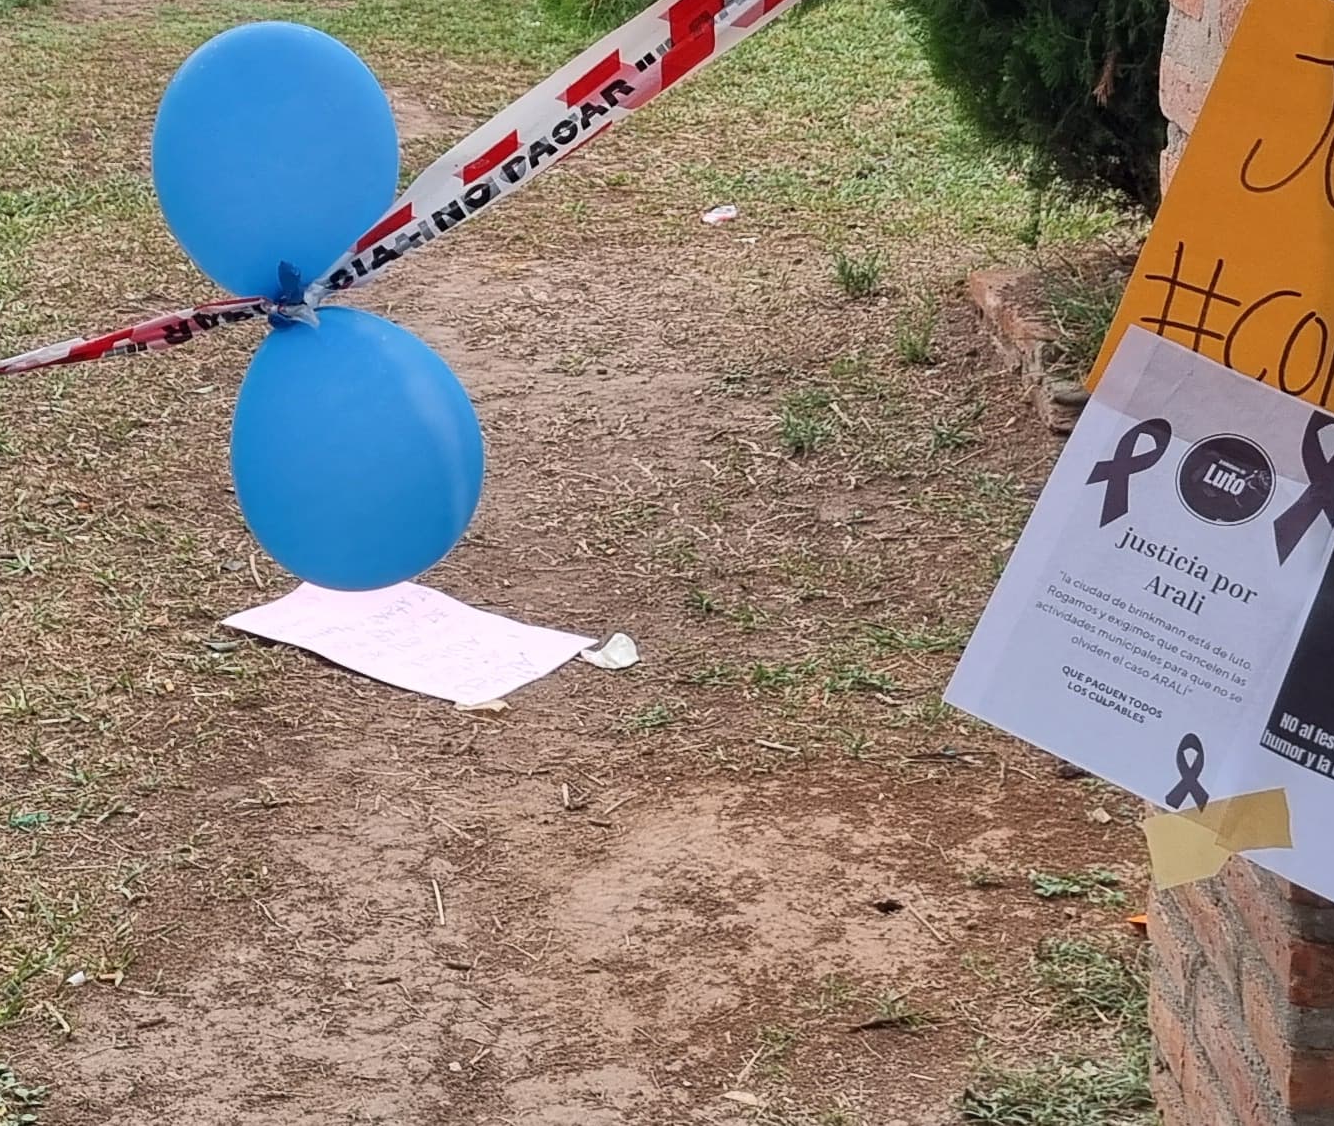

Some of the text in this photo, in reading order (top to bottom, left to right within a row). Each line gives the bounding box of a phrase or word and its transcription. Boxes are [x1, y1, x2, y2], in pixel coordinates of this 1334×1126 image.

[1202, 462, 1246, 496] Luto
[1114, 526, 1259, 606] justicia por
[1142, 574, 1207, 617] Arali
[1046, 584, 1098, 616] Rogamos
[1107, 611, 1156, 642] exigimos
[1156, 636, 1179, 656] que
[1179, 647, 1230, 680] cancelen
[1231, 670, 1247, 687] las
[1072, 576, 1112, 603] ciudad
[1111, 593, 1127, 610] de
[1127, 602, 1187, 639] brinkmann
[1187, 630, 1212, 653] está
[1212, 642, 1228, 659] de
[1228, 649, 1253, 672] luto.
[1035, 599, 1243, 704] actividades municipales para que no se
[1070, 634, 1111, 661] olviden
[1112, 651, 1123, 666] el
[1123, 658, 1150, 678] caso
[1061, 665, 1164, 720] QUE PAGUEN TODOS
[1067, 680, 1146, 725] LOS CULPABLES
[1279, 712, 1299, 734] NO
[1298, 719, 1314, 740] al
[1261, 729, 1306, 762] humor
[1316, 755, 1330, 775] la
